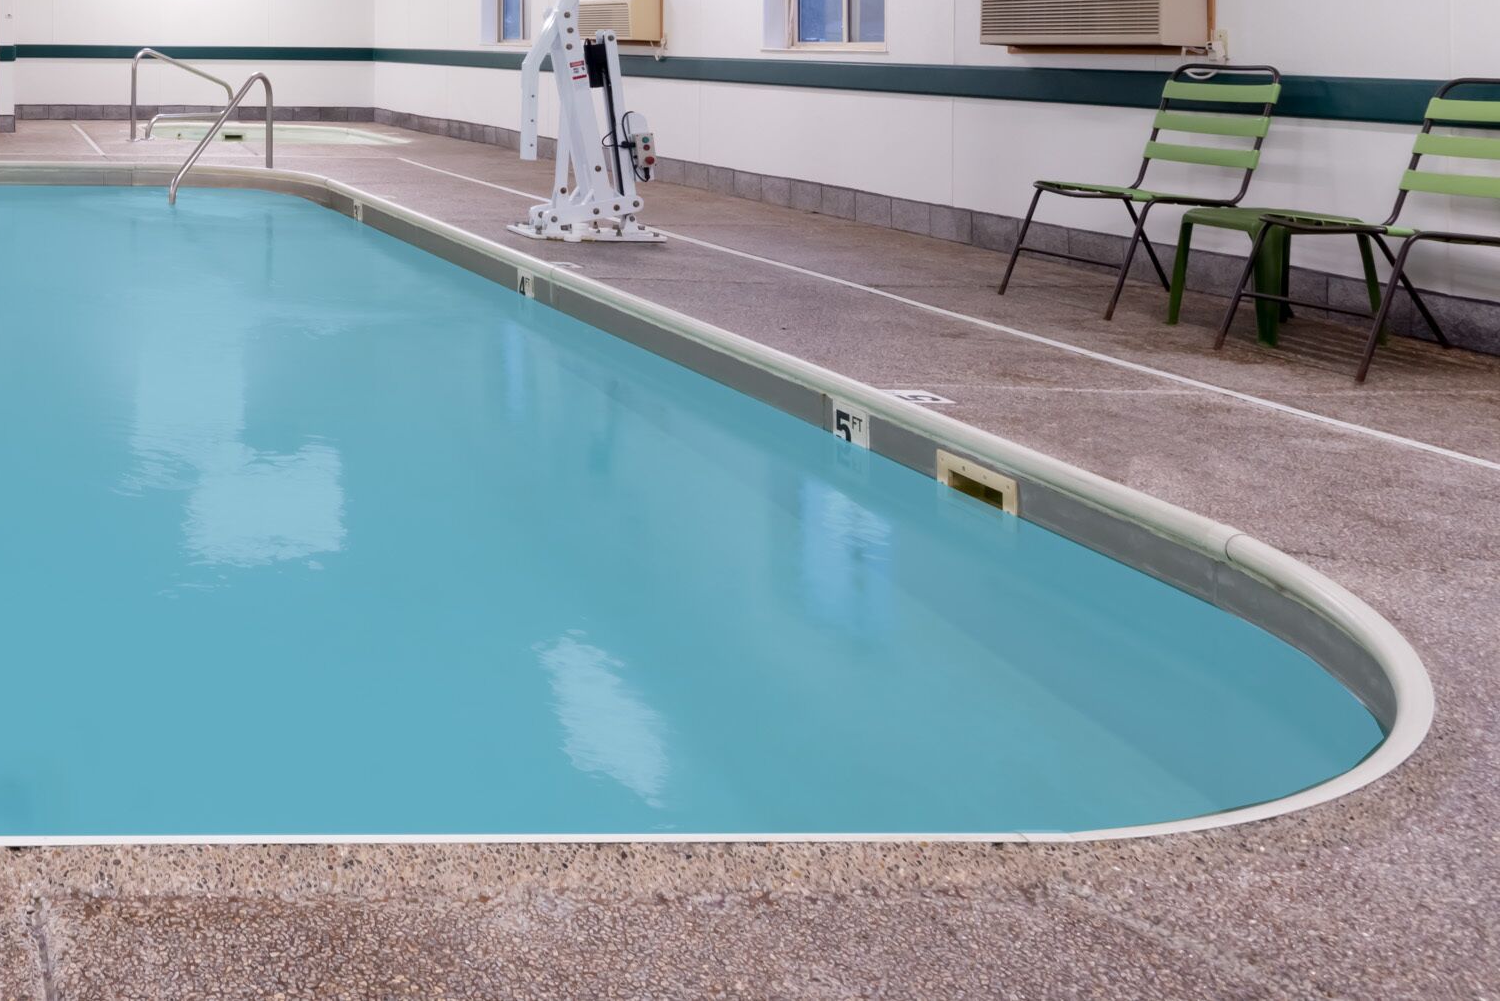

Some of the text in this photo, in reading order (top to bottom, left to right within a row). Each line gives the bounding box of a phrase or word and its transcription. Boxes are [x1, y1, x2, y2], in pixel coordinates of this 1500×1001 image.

[519, 275, 526, 296] 4
[836, 408, 863, 443] 5 FT
